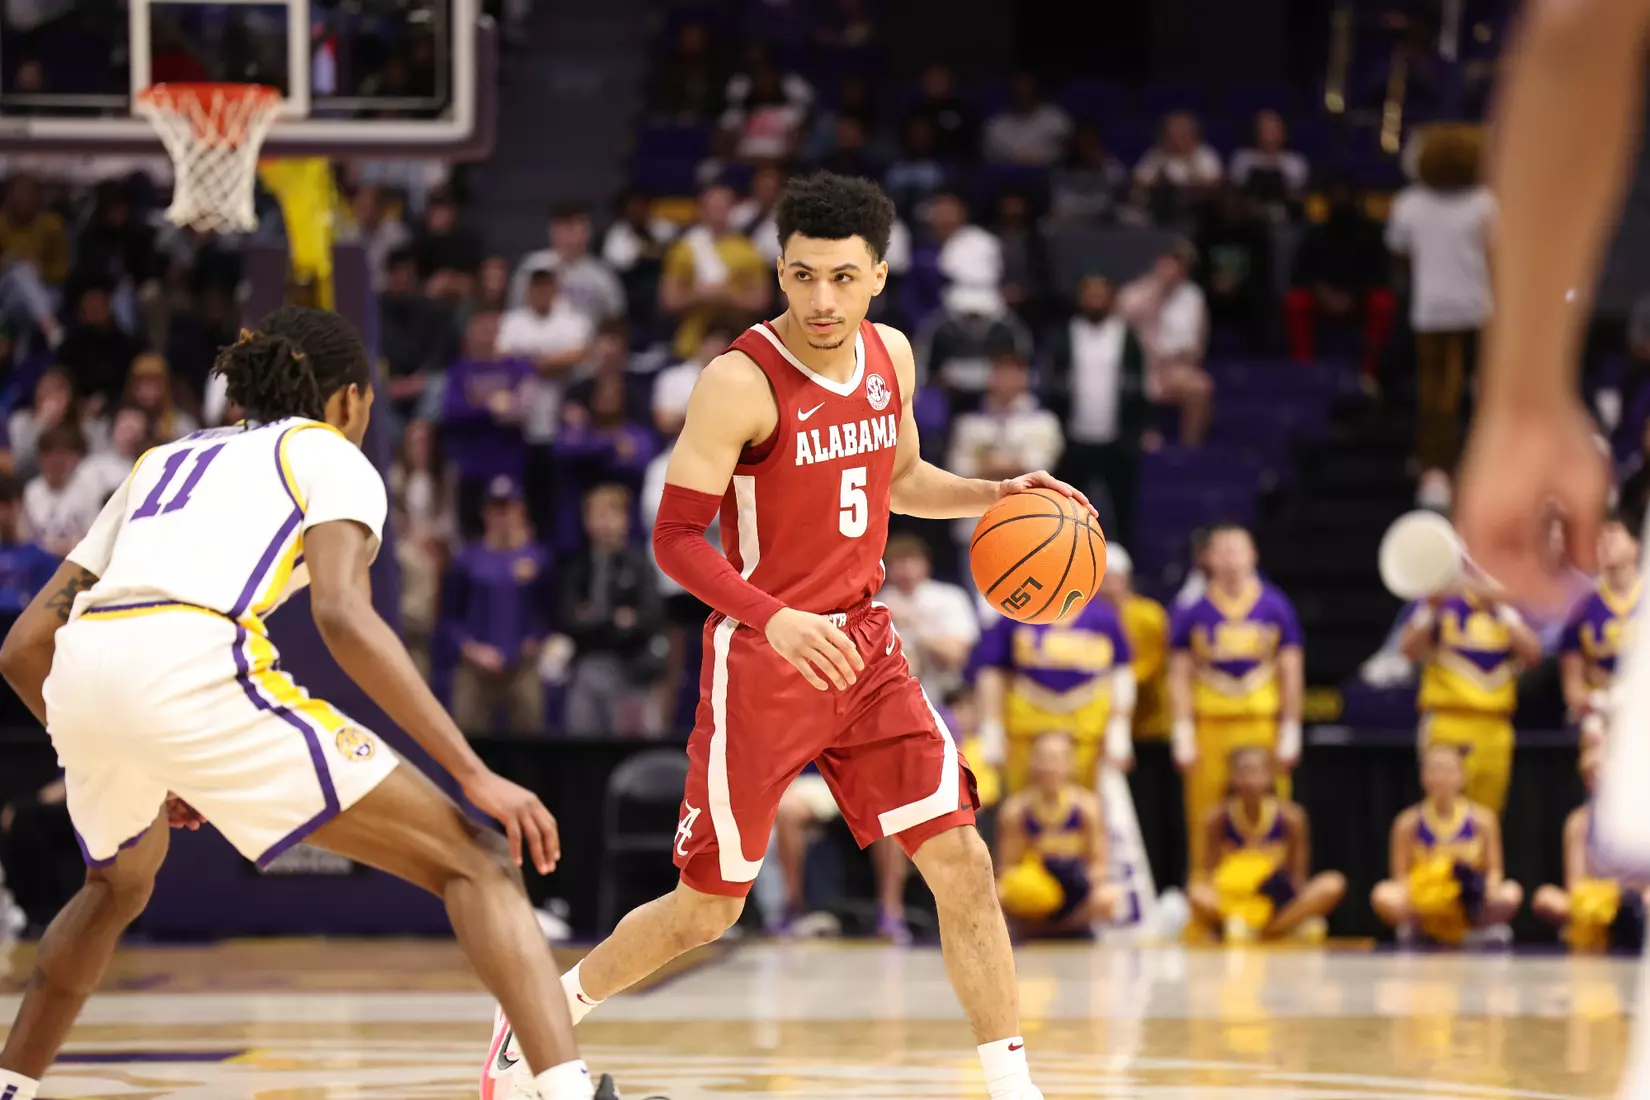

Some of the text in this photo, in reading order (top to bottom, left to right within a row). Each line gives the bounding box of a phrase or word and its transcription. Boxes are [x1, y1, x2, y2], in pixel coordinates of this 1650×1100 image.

[795, 413, 897, 466] ALABAMA
[129, 442, 228, 522] 11
[839, 466, 868, 538] 5
[1001, 576, 1043, 614] LSU
